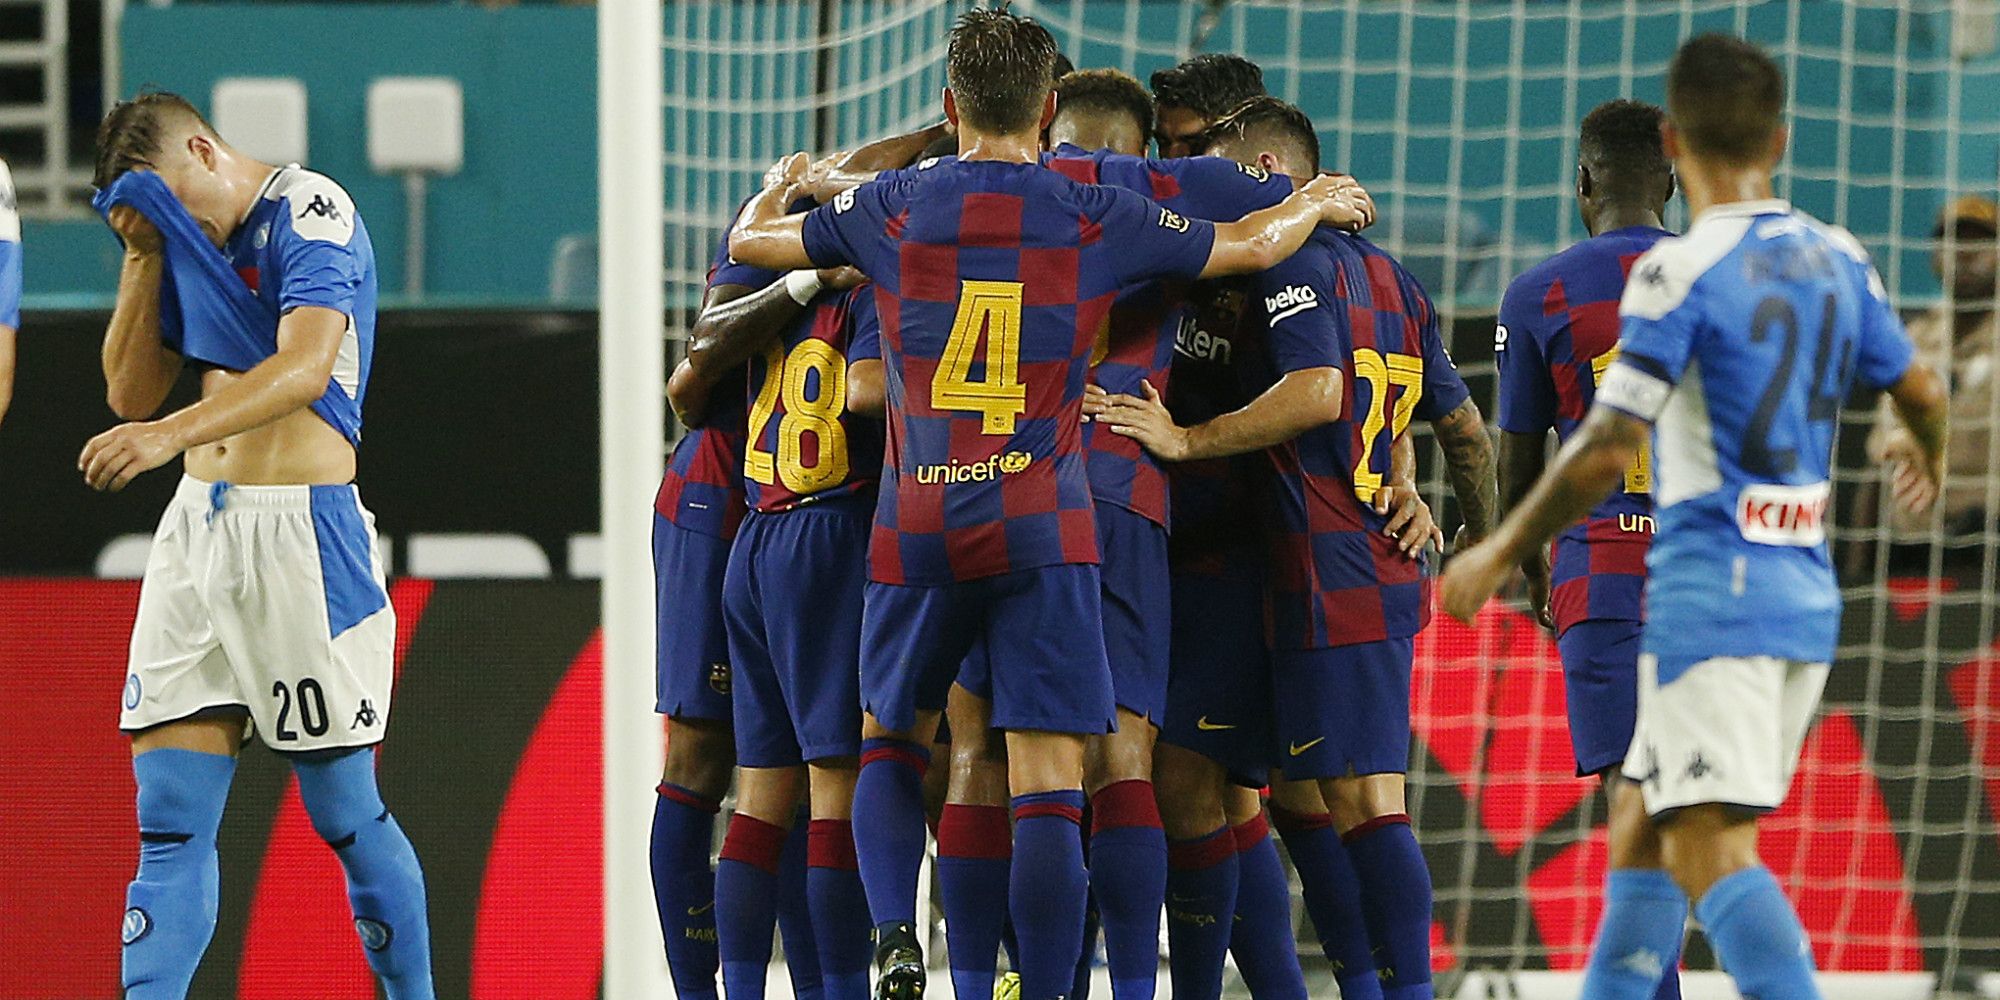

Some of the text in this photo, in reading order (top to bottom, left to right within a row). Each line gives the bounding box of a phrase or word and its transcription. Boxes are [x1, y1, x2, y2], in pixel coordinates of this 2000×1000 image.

[1264, 285, 1318, 315] beko
[931, 279, 1026, 435] 4
[1741, 291, 1851, 477] 24
[743, 336, 850, 495] 28
[916, 453, 999, 484] unicef
[1352, 347, 1424, 504] 27
[1618, 512, 1657, 535] un
[272, 677, 330, 742] 20
